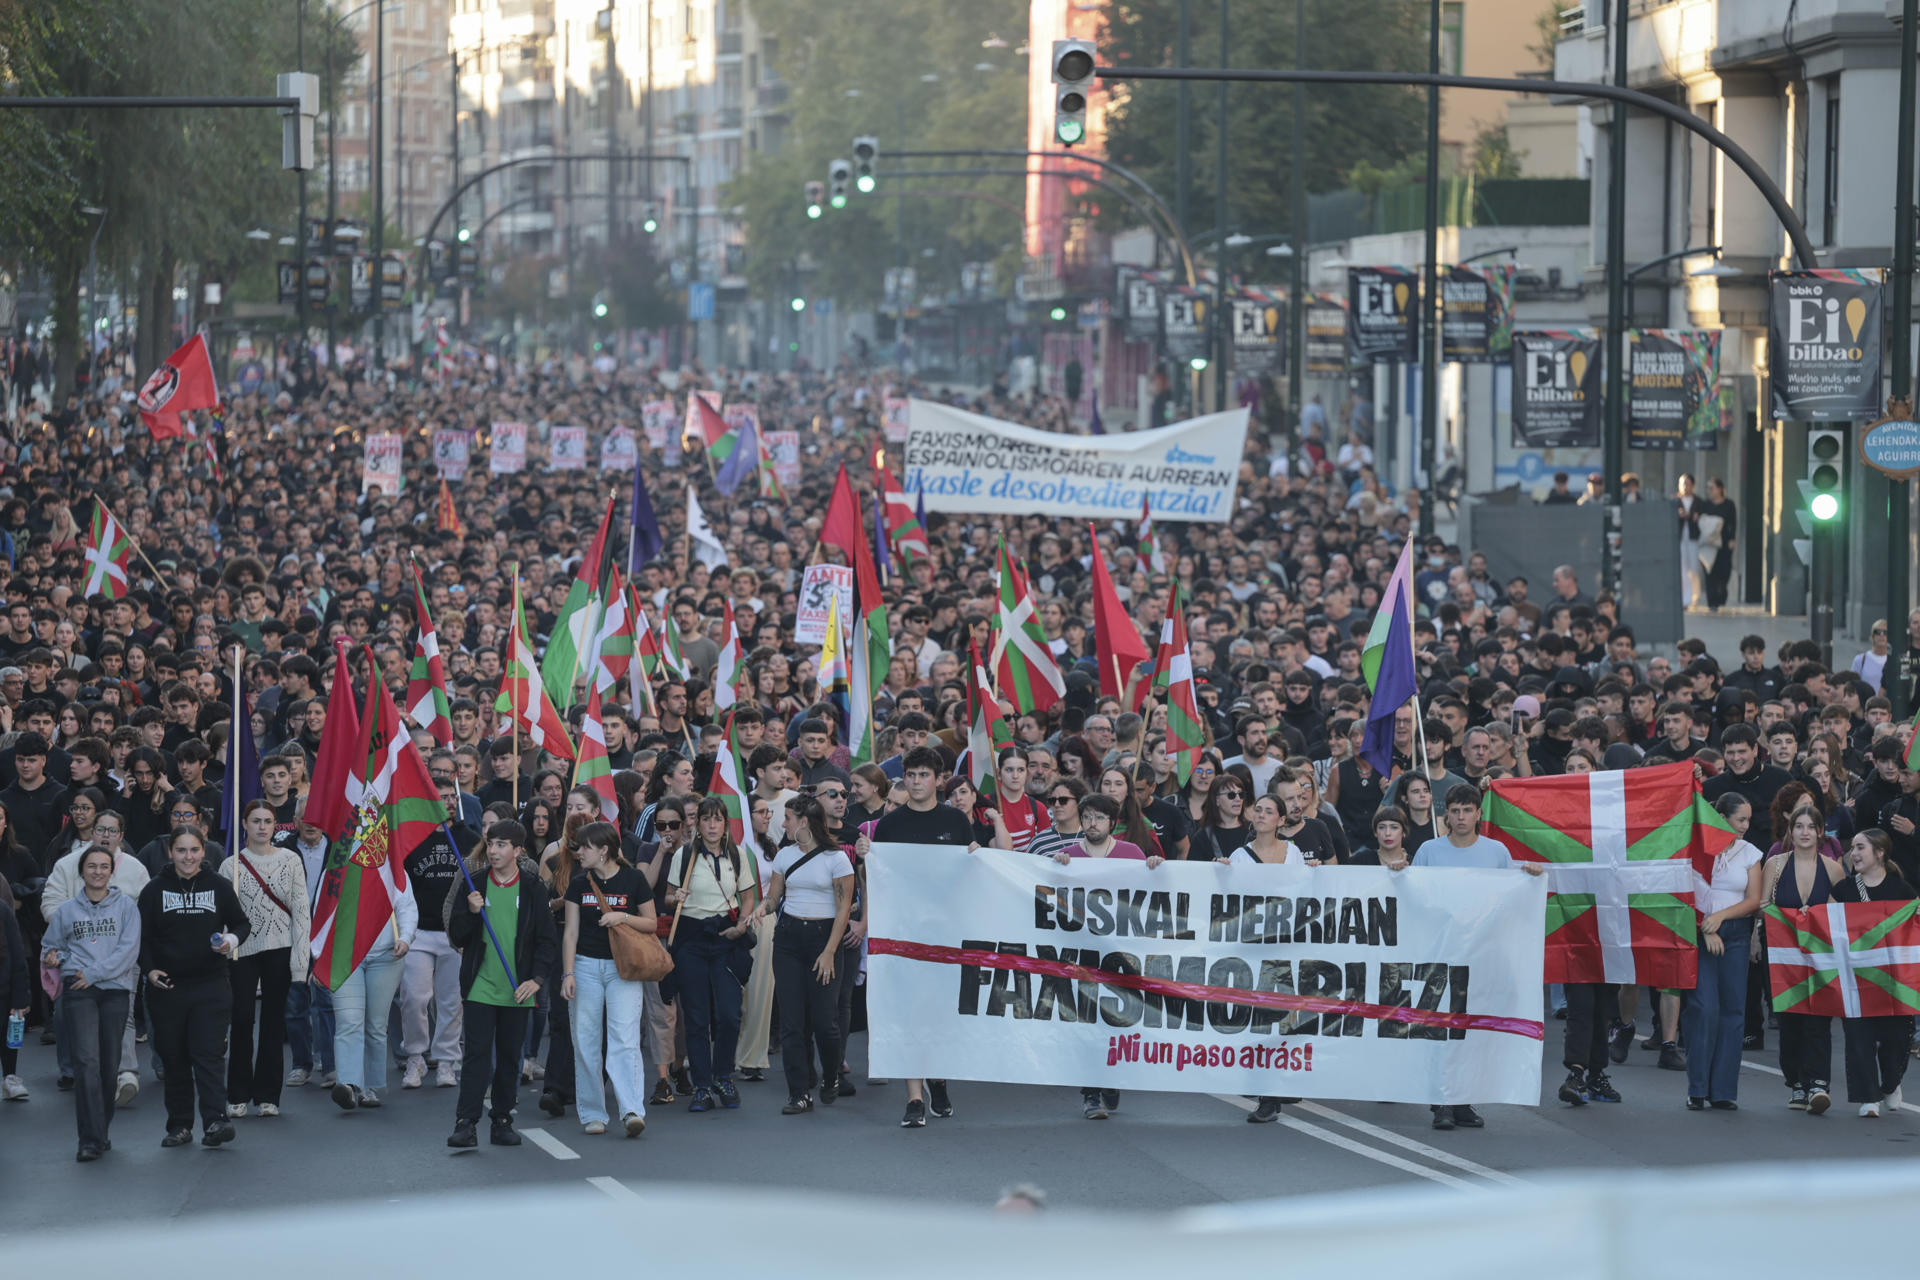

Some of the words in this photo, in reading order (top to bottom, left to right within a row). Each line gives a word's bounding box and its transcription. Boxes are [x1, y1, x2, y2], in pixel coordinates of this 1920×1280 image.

[1789, 345, 1863, 361] bilbao
[1632, 363, 1685, 376] BIZKAIKO
[1632, 375, 1684, 388] AHOTSAK
[1788, 374, 1819, 384] Mucho
[1526, 388, 1585, 401] bilbao
[1788, 385, 1800, 393] un
[1801, 384, 1845, 393] concierto
[1882, 422, 1918, 433] AVENIDA
[1867, 435, 1920, 448] LEHENDAK
[908, 449, 1126, 480] ESPAINIOLISMOAREN
[1129, 464, 1232, 487] AURREAN
[906, 466, 984, 497] ikasle
[990, 472, 1223, 515] desobedientzia!
[808, 568, 853, 588] ANTI
[413, 853, 459, 877] CALIFOR
[1035, 885, 1196, 940] EUSKAL
[1208, 893, 1398, 947] HERRIAN
[958, 940, 1367, 1038] FAXISMOARI
[1143, 1041, 1173, 1064] un
[1176, 1043, 1235, 1071] paso
[1238, 1041, 1312, 1071] atrás!
